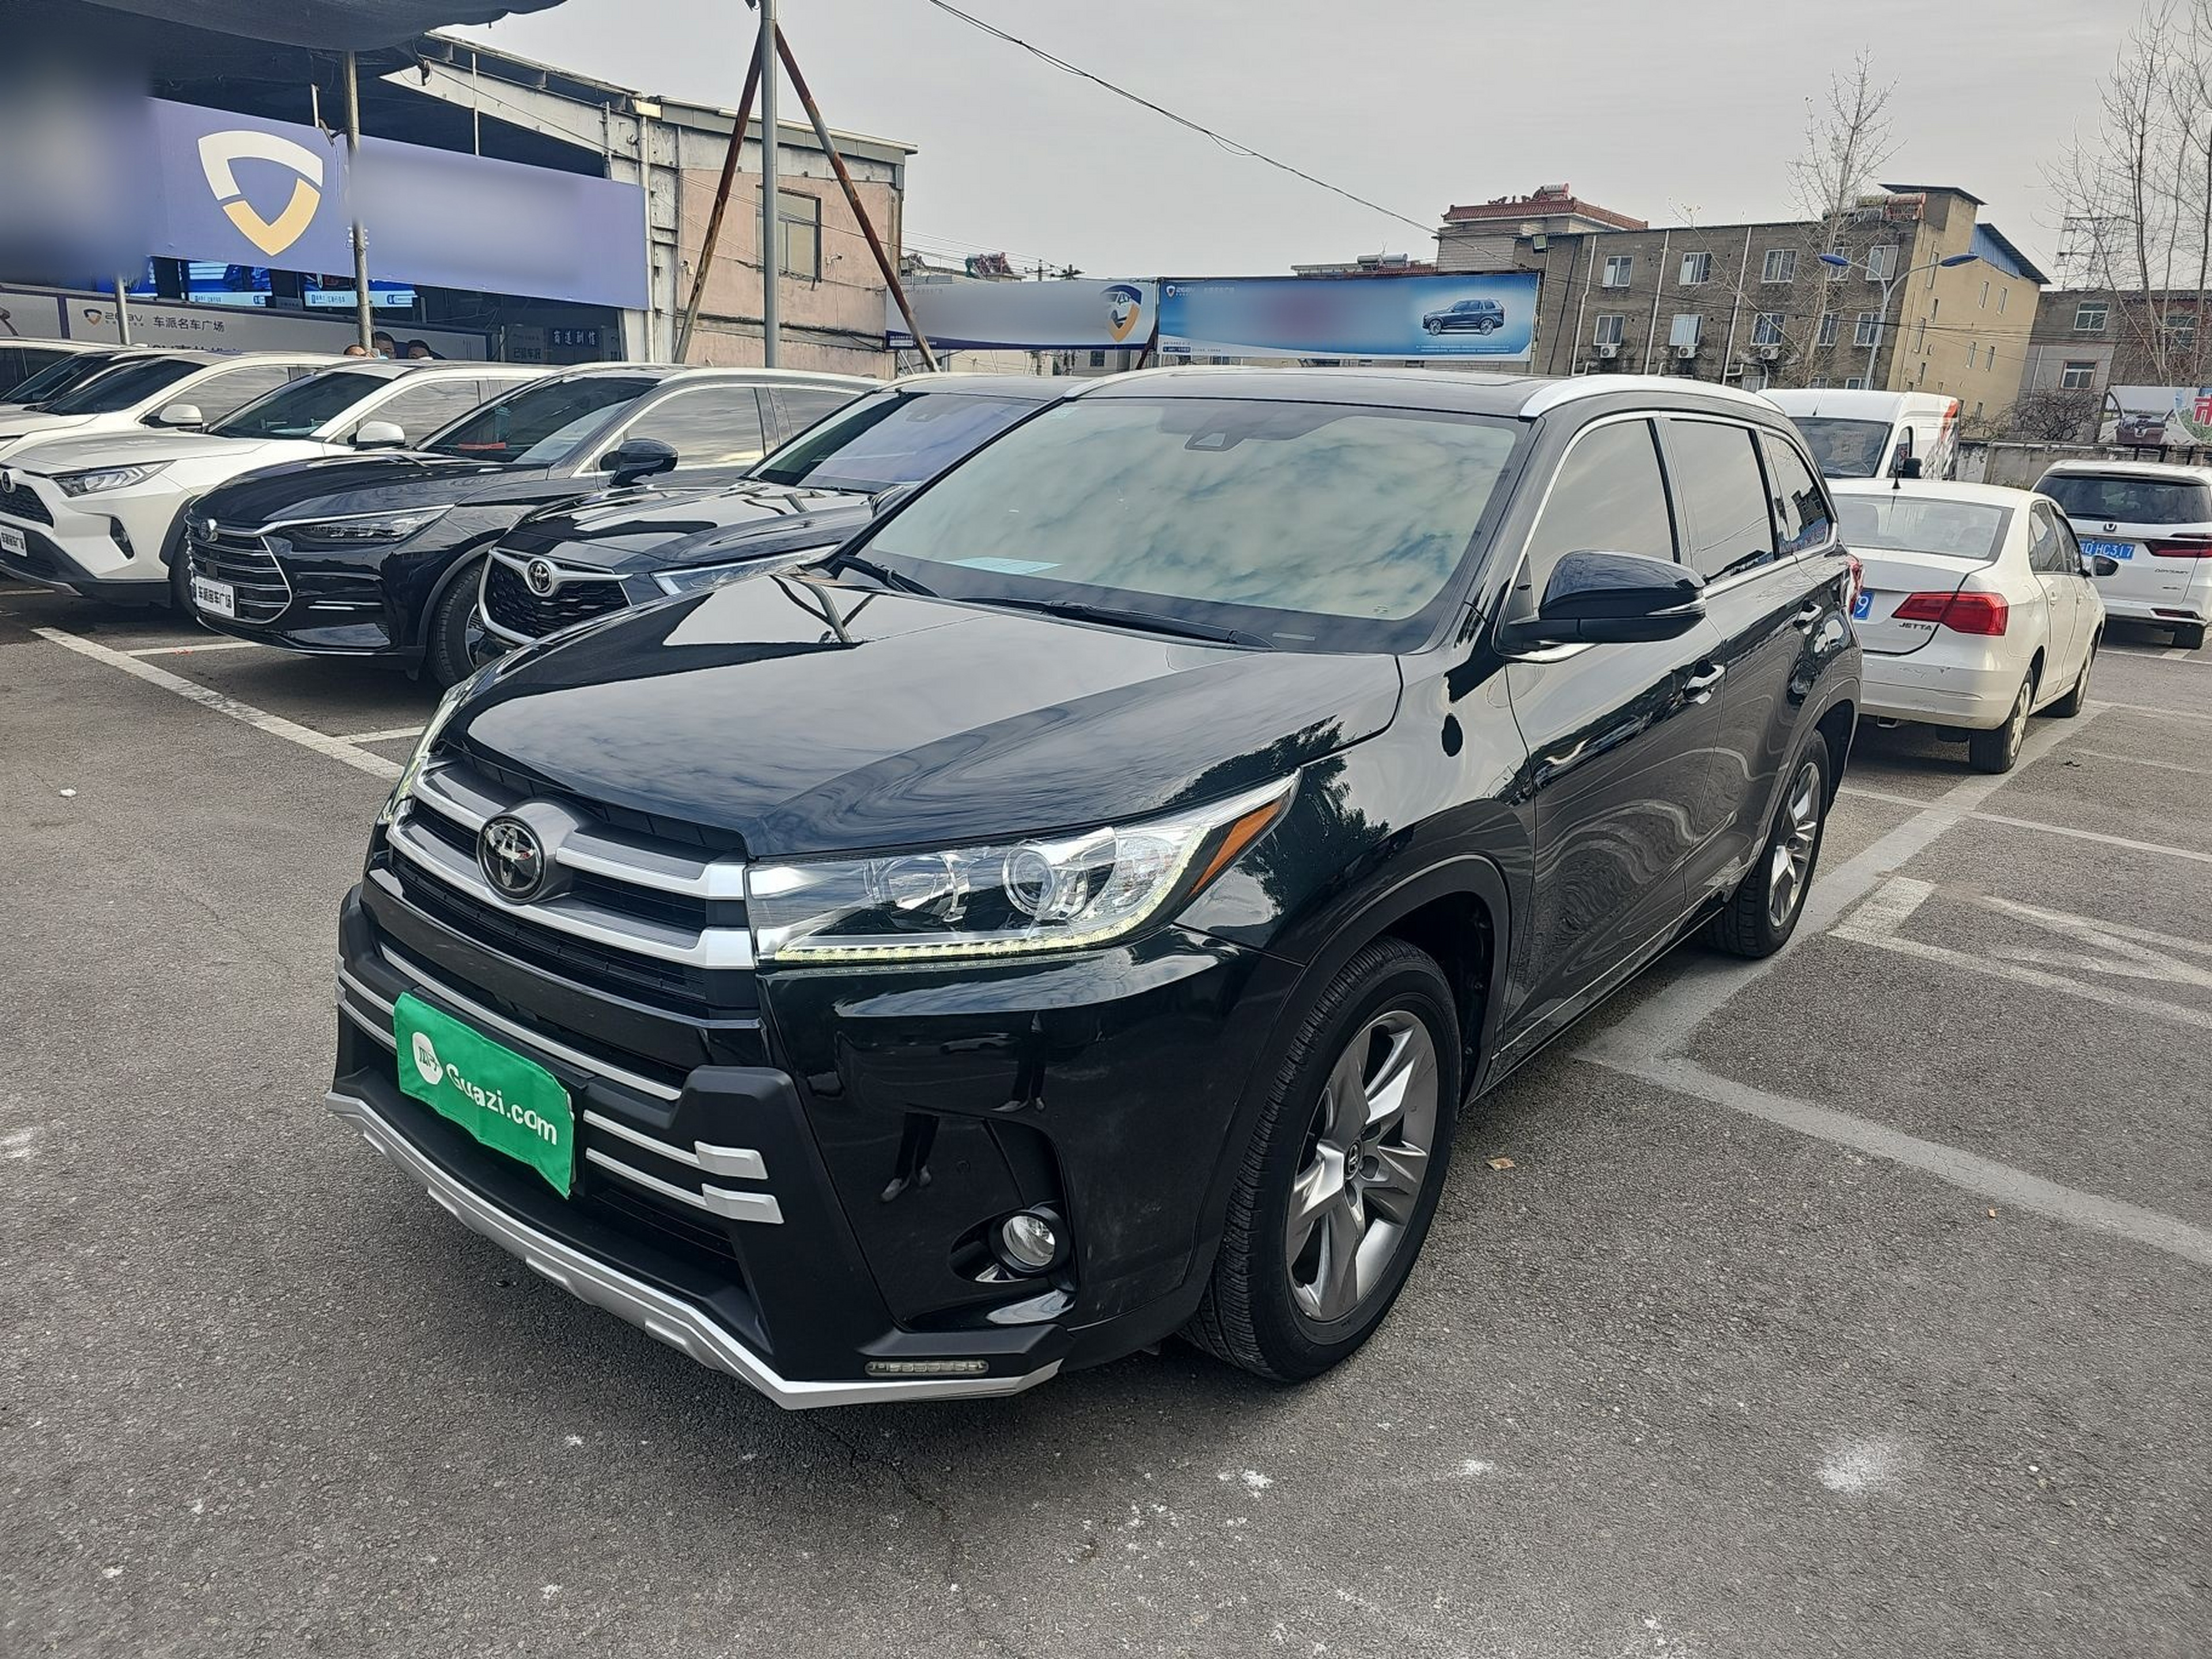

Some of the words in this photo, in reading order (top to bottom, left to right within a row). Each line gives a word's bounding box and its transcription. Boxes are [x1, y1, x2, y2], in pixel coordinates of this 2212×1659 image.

[153, 315, 225, 332] 车派名车广场
[1899, 622, 1933, 631] JETTA
[446, 1063, 558, 1146] Guazi.com
